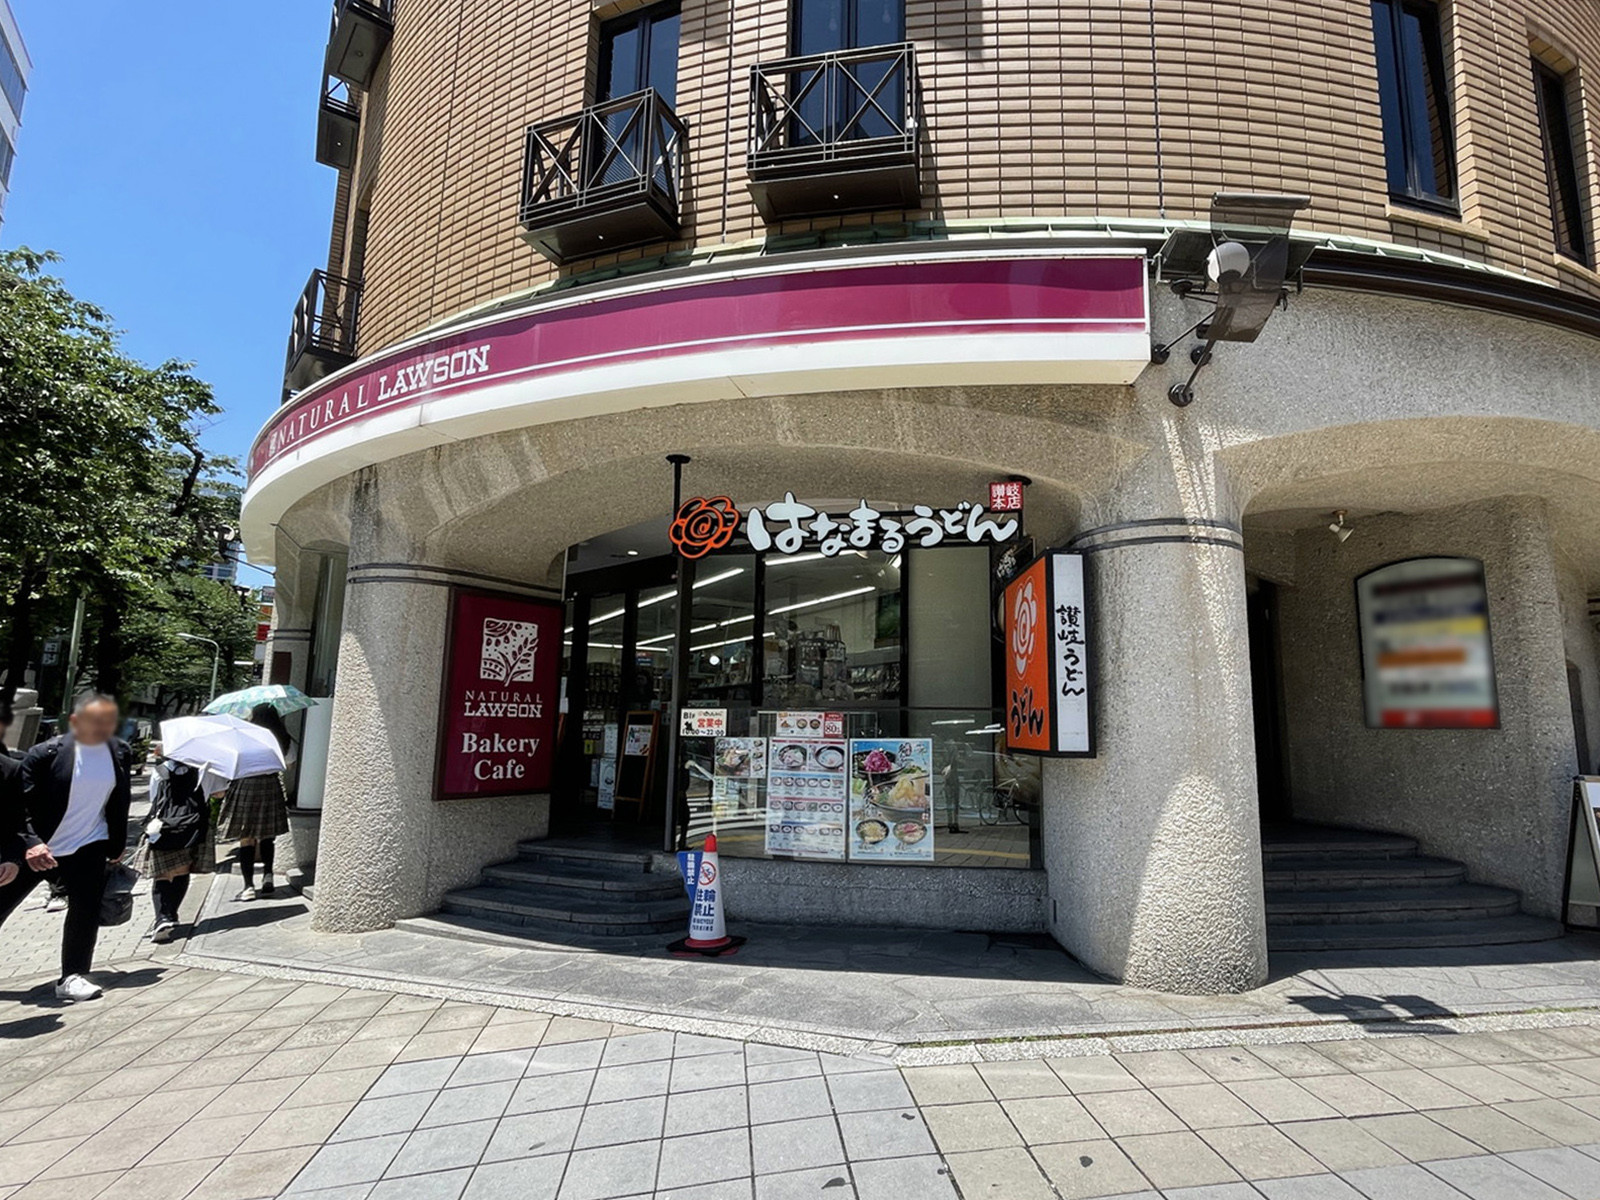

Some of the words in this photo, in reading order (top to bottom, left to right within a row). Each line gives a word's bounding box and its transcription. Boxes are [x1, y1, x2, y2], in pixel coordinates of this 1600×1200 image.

[277, 385, 369, 450] NATURAL
[377, 344, 491, 401] LAWSON
[991, 497, 1021, 510] 本店
[747, 491, 1018, 556] はなまるうどん
[1055, 604, 1085, 697] 讃岐うどん
[464, 690, 543, 703] NATURAL
[463, 702, 543, 718] LAWSON
[1010, 686, 1044, 739] うどん
[461, 732, 540, 757] Bakery
[474, 759, 526, 780] Cafe
